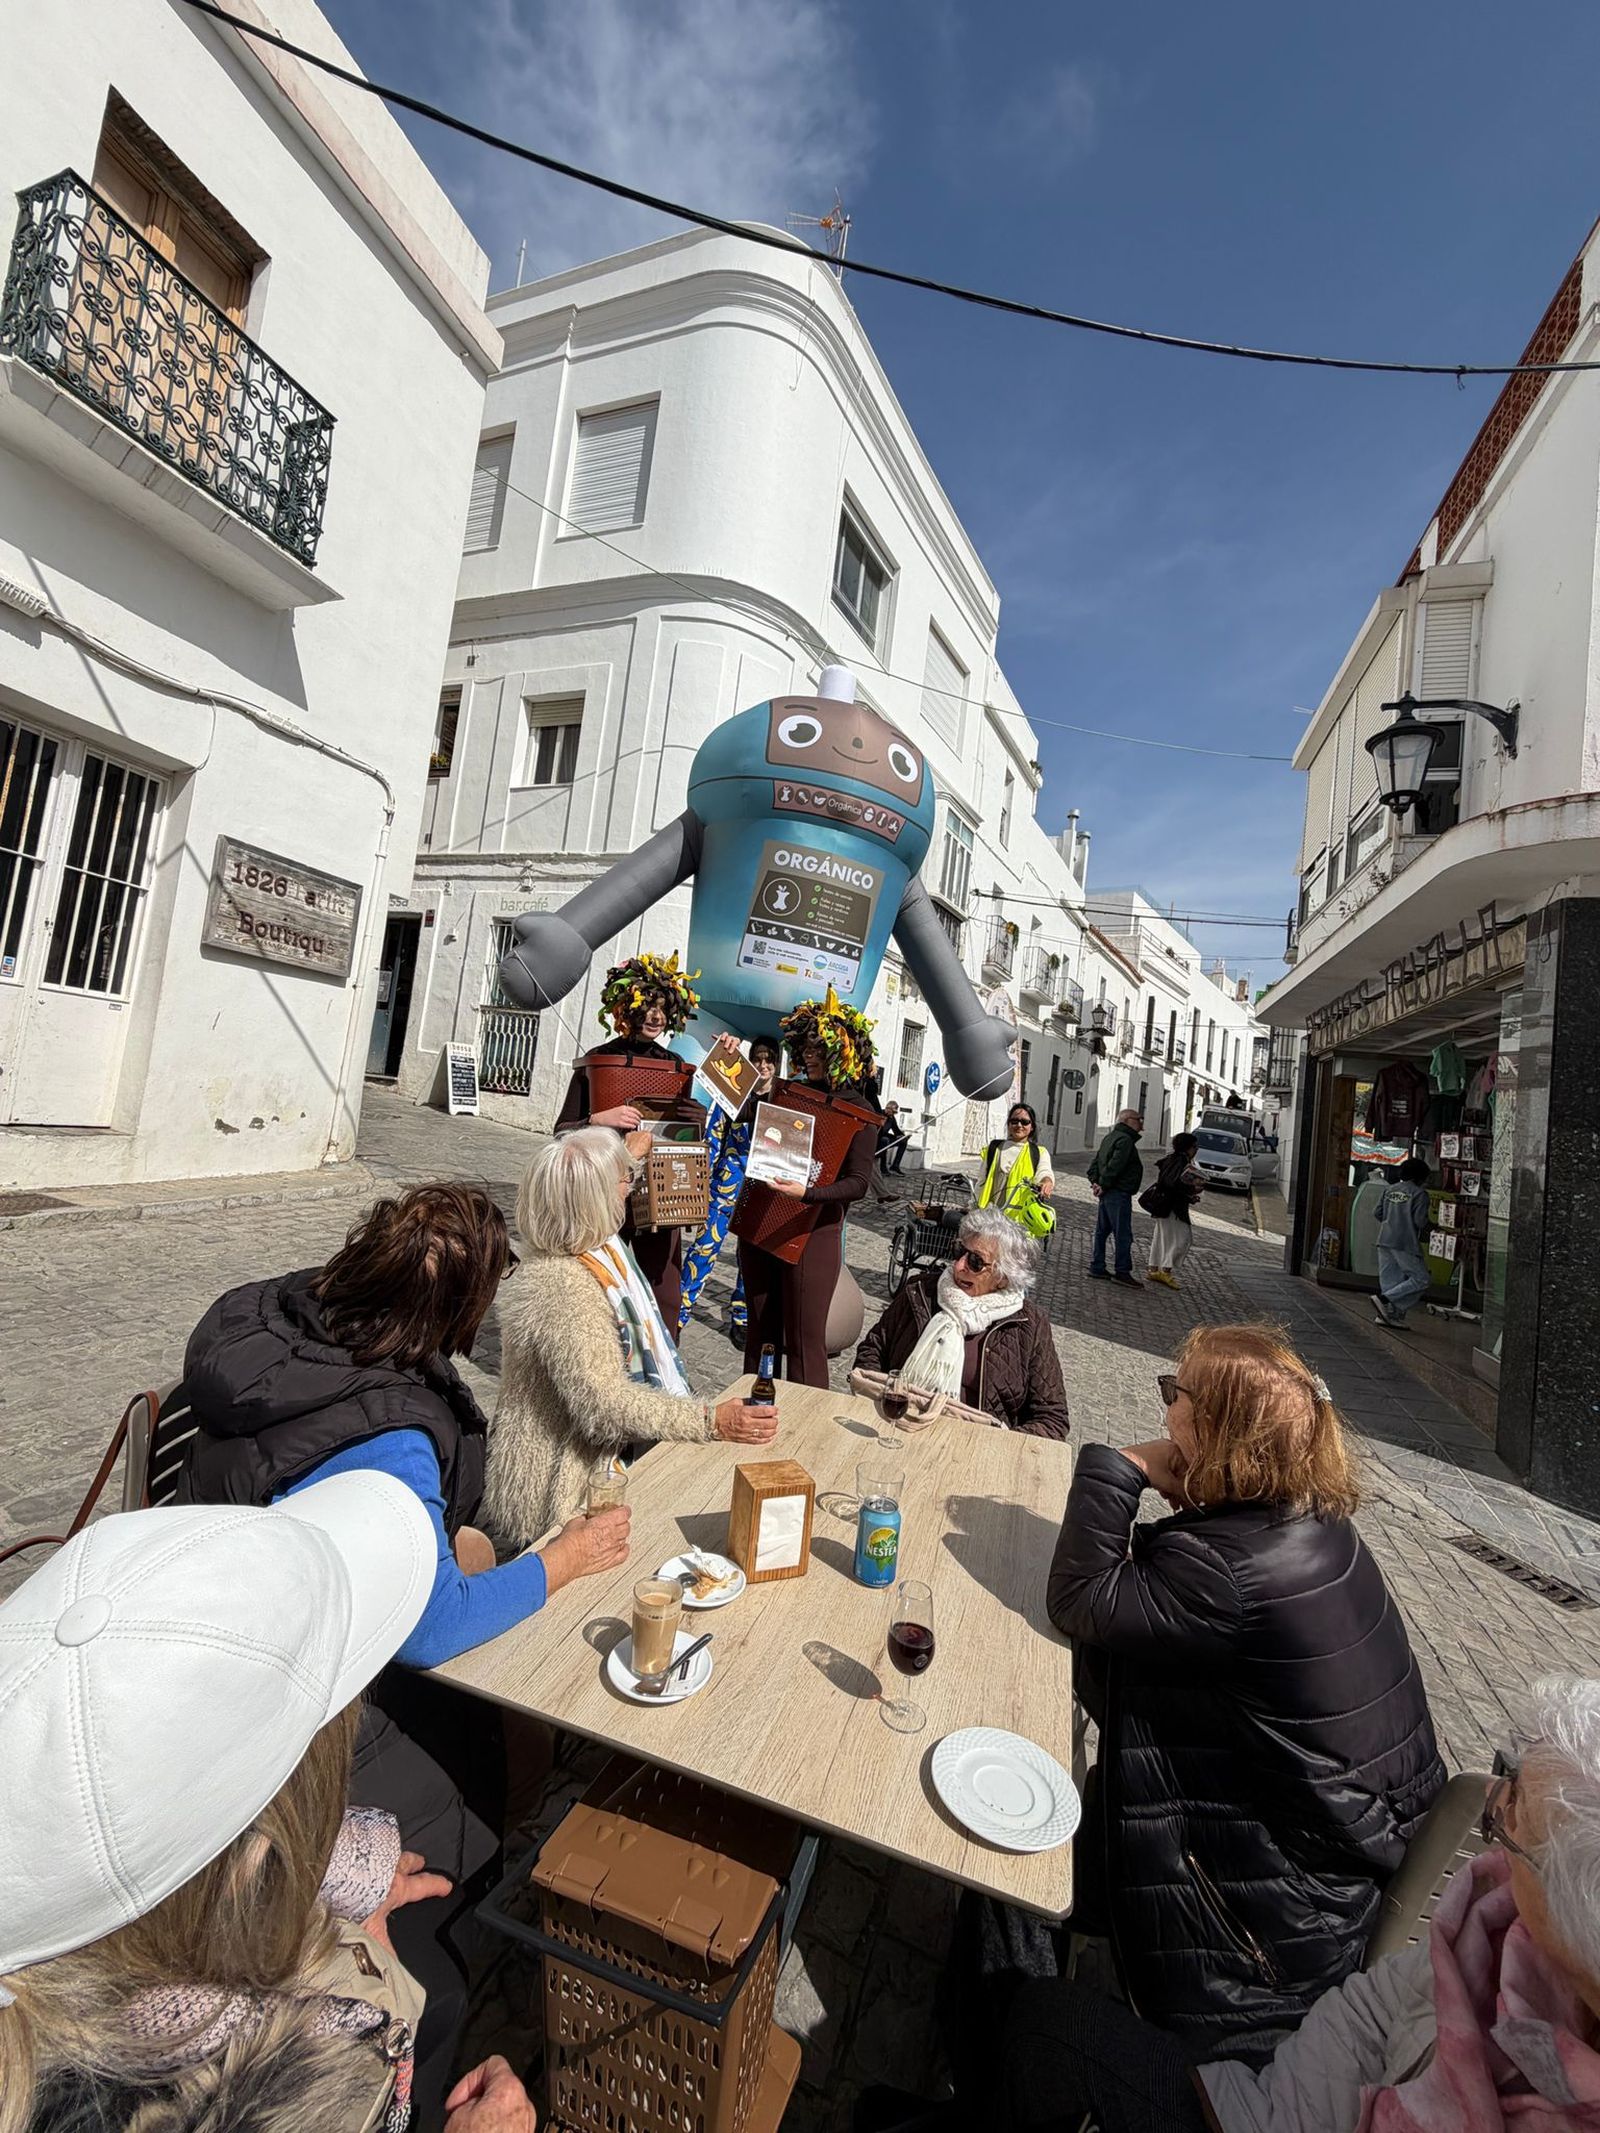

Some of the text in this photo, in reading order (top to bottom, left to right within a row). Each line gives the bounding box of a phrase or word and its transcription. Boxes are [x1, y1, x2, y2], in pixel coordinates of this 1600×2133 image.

[828, 798, 862, 816] Orgánica
[774, 849, 874, 889] ORGÁNICO
[231, 862, 289, 897] 1826
[500, 897, 549, 912] bar.café
[865, 1545, 897, 1557] NESTEA
